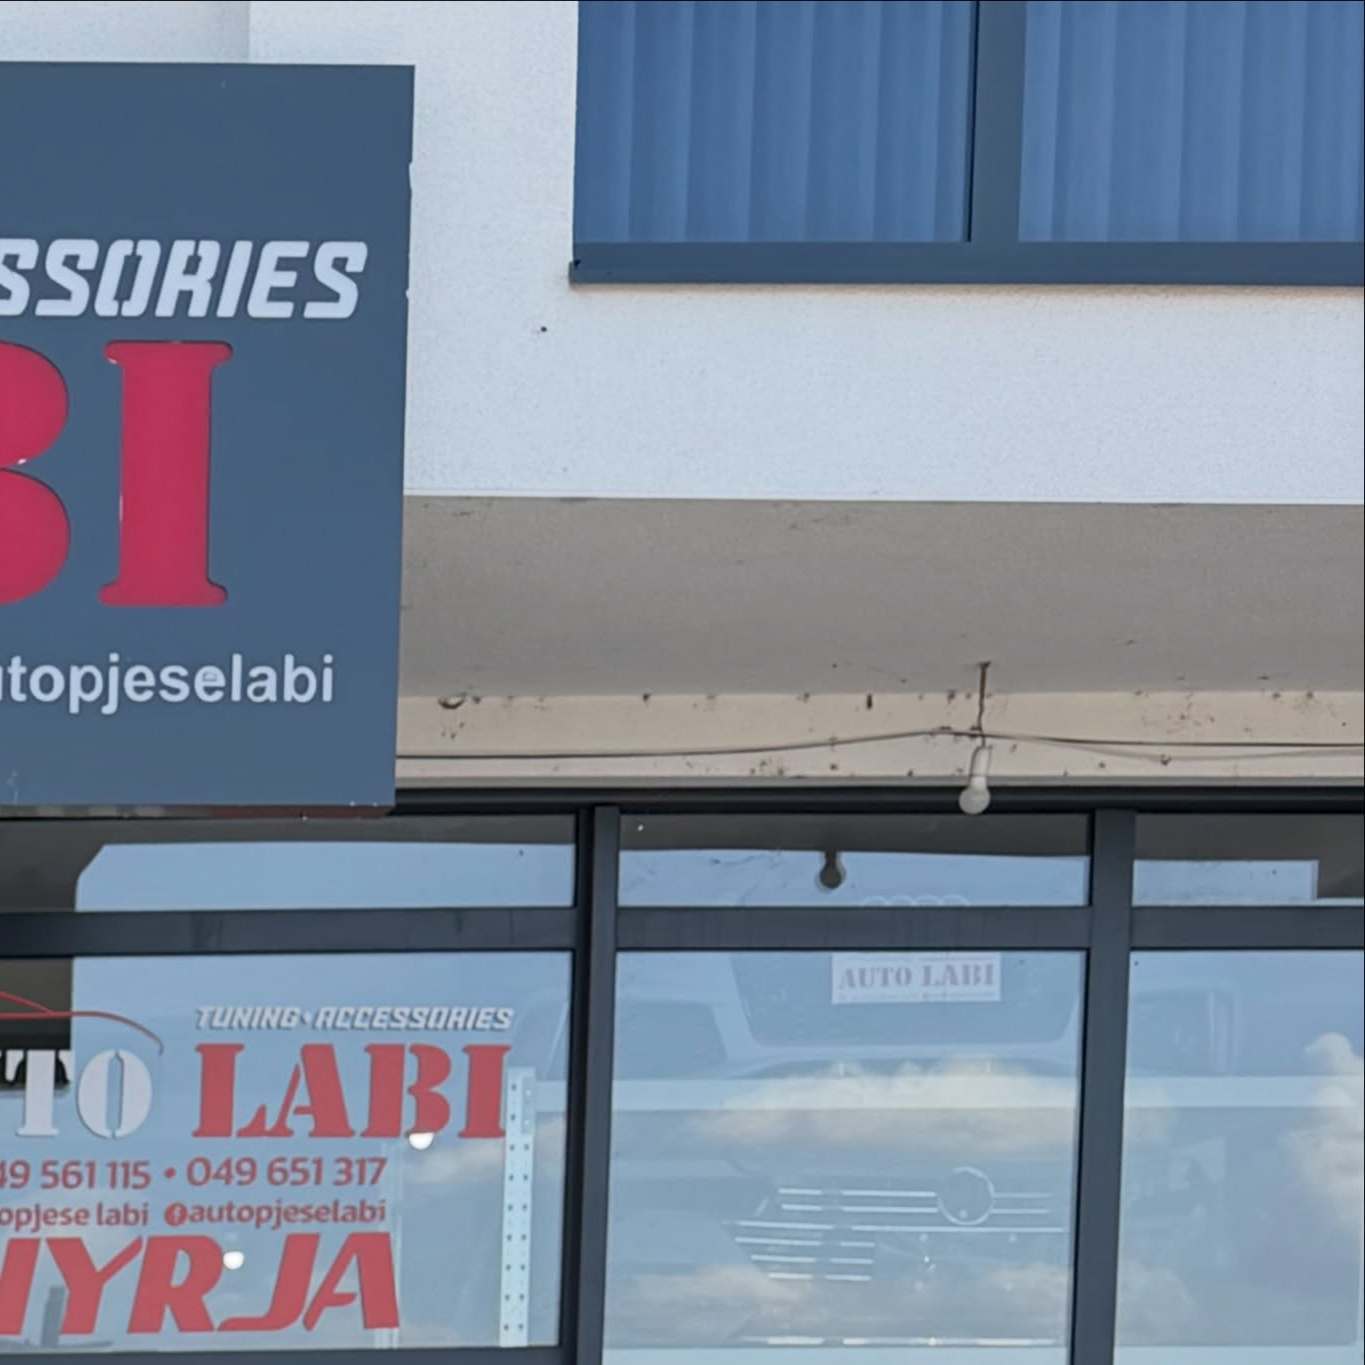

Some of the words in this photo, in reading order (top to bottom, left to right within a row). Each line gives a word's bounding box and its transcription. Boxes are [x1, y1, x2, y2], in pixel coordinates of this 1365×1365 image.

[839, 968, 912, 989] AUTO
[922, 963, 994, 987] LABI
[196, 1006, 301, 1029] TUNING
[192, 1043, 510, 1139] LABI
[41, 1160, 96, 1188] 561
[107, 1161, 151, 1189] 115
[186, 1157, 257, 1186] 049
[267, 1157, 324, 1185] 651
[333, 1157, 386, 1185] 317
[188, 1199, 386, 1230] autopjeselabi
